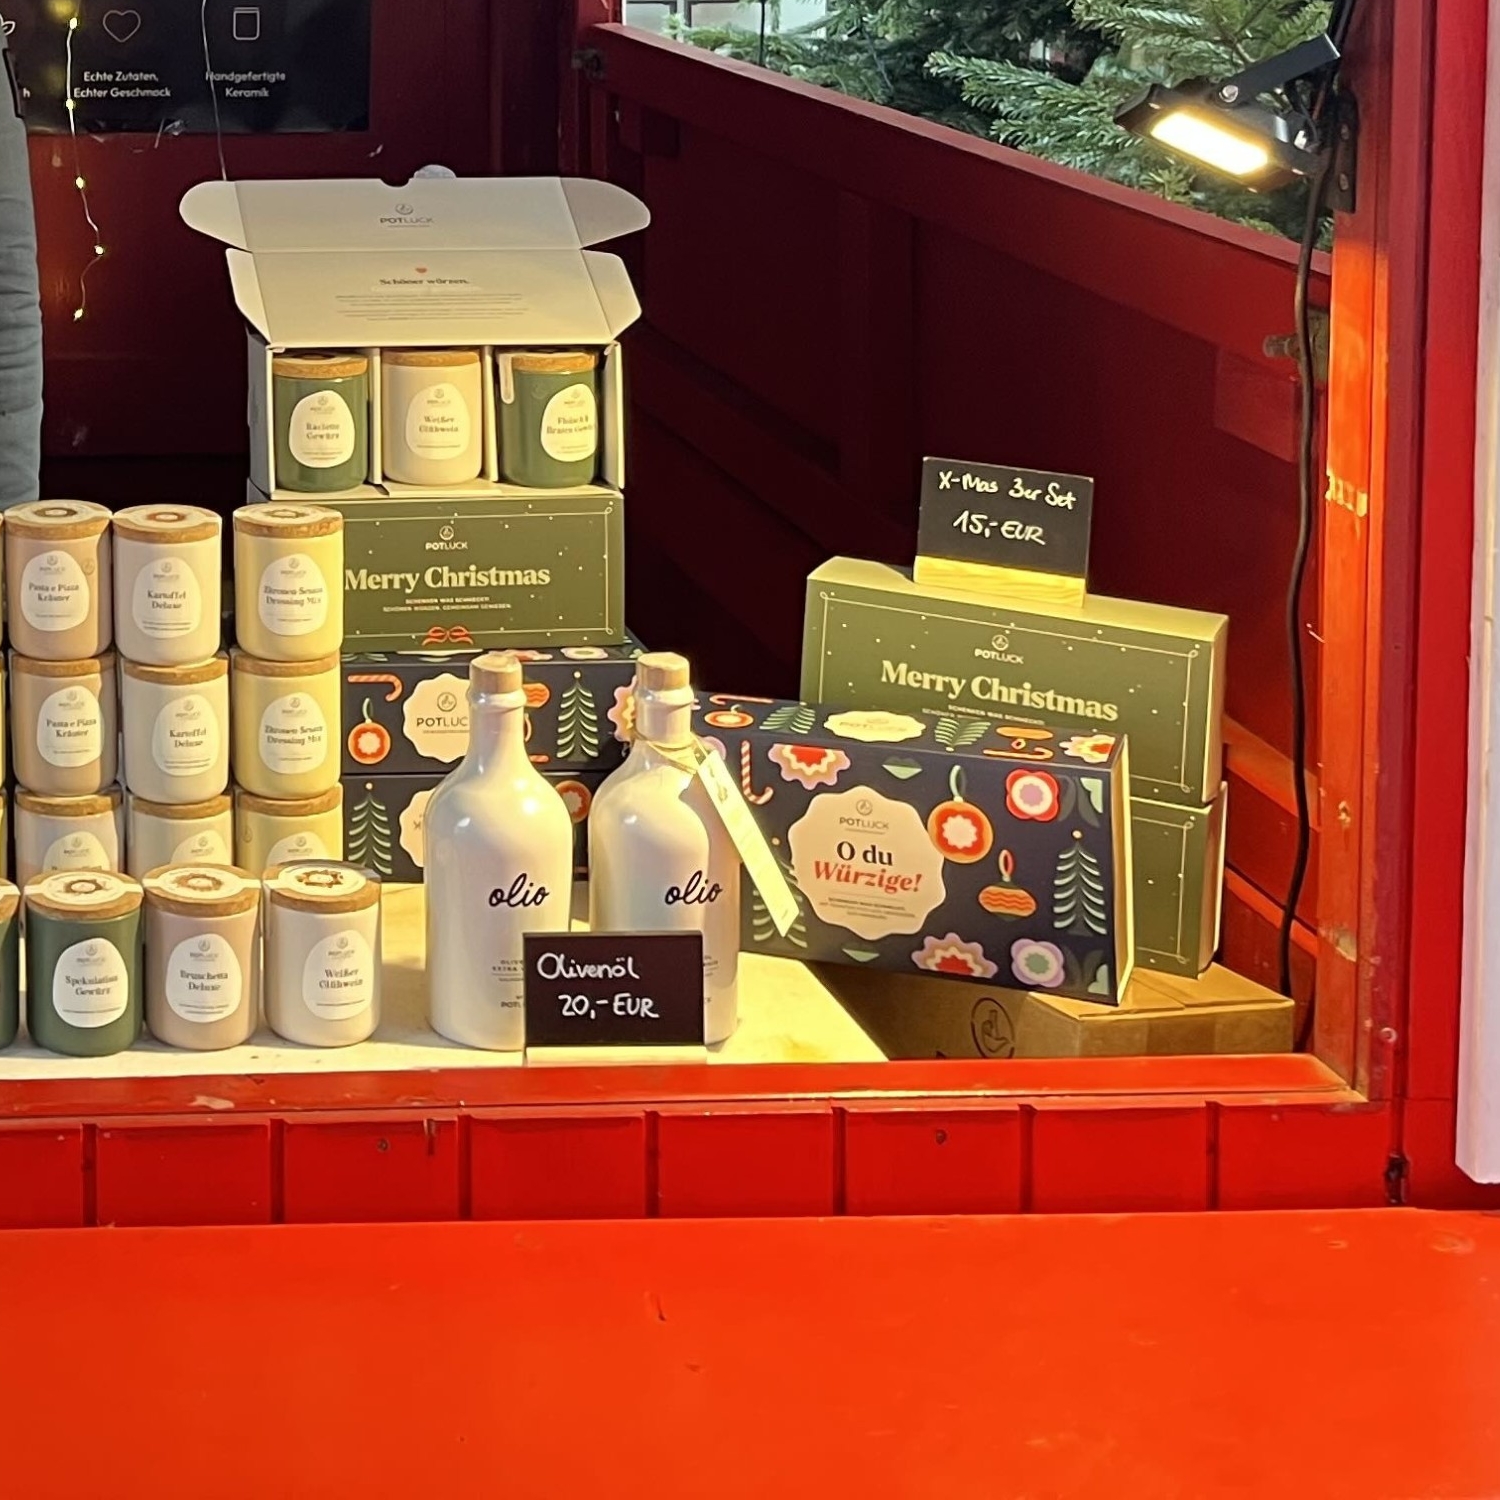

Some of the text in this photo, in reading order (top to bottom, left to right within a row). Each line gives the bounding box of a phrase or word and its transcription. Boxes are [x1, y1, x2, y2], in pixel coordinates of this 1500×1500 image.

[83, 71, 113, 82] Echte
[205, 71, 286, 83] Handgefertigte
[73, 87, 171, 98] Echter Geschmack
[225, 87, 270, 98] Keramik
[1044, 482, 1077, 510] Set
[425, 541, 469, 551] POTLUCK
[1000, 520, 1046, 546] EUR
[344, 564, 551, 594] Merry Christmas
[974, 648, 1024, 666] POTLUCK
[880, 659, 1120, 723] Merry Christmas
[416, 716, 469, 728] POTLUC
[839, 817, 889, 831] POTLUCK
[836, 841, 893, 867] O du
[664, 870, 723, 906] olio
[813, 859, 923, 895] Würzige!
[488, 873, 550, 908] olio
[537, 952, 640, 982] Olivenöl
[75, 985, 112, 996] Gewürz
[613, 993, 660, 1019] EUR
